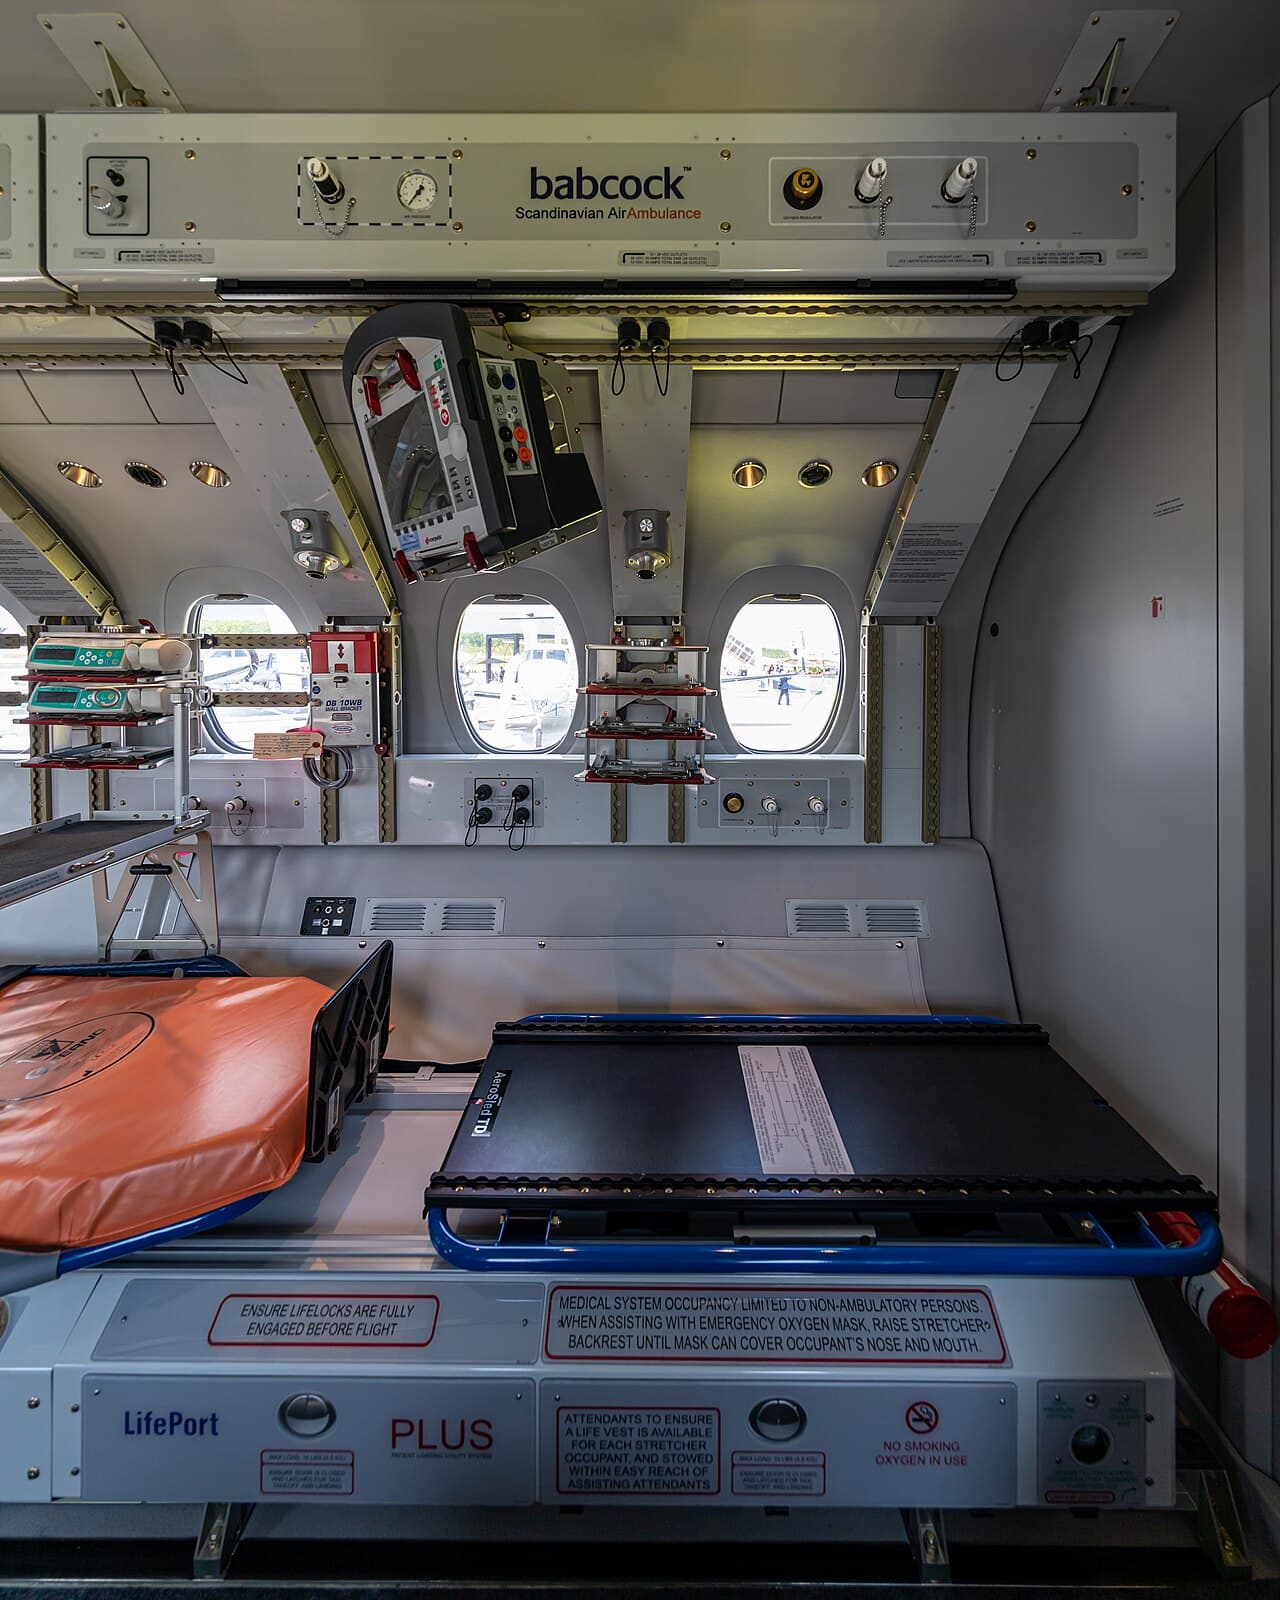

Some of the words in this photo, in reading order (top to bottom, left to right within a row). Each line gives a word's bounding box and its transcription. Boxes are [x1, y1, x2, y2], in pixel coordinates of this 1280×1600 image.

[530, 166, 685, 200] babcock
[516, 206, 604, 220] Scandinavian
[608, 206, 701, 220] AirAmbulance
[480, 1072, 506, 1116] AeroSled
[474, 1118, 490, 1134] TD
[240, 1304, 290, 1317] ENSURE
[290, 1304, 353, 1318] LIFELOCKS
[352, 1304, 378, 1318] ARE
[378, 1305, 414, 1318] FULLY
[560, 1296, 611, 1310] MEDICAL
[614, 1296, 662, 1310] SYSTEM
[664, 1297, 737, 1311] OCCUPANCY
[742, 1298, 787, 1312] LIMITED
[792, 1298, 806, 1312] TO
[810, 1298, 917, 1312] NON-AMBULATORY
[922, 1300, 982, 1312] PERSONS.
[246, 1322, 305, 1336] ENGAGED
[306, 1322, 354, 1336] BEFORE
[356, 1323, 398, 1336] FLIGHT
[561, 1315, 596, 1328] WHEN
[600, 1316, 662, 1329] ASSISTING
[666, 1316, 696, 1329] WITH
[700, 1316, 774, 1330] EMERGENCY
[778, 1317, 828, 1331] OXYGEN
[832, 1318, 870, 1332] MASK,
[874, 1318, 908, 1332] RAISE
[912, 1318, 984, 1332] STRETCHER
[568, 1334, 633, 1349] BACKREST
[636, 1335, 670, 1349] UNTIL
[674, 1336, 708, 1350] MASK
[712, 1336, 736, 1350] CAN
[741, 1336, 783, 1350] COVER
[787, 1336, 864, 1351] OCCUPANT'S
[867, 1338, 902, 1351] NOSE
[905, 1338, 930, 1352] AND
[934, 1338, 982, 1352] MOUTH.
[124, 1411, 219, 1436] LifePort
[564, 1414, 642, 1424] ATTENDANTS
[645, 1414, 661, 1424] TO
[664, 1414, 712, 1424] ENSURE
[392, 1418, 494, 1450] PLUS
[565, 1427, 574, 1437] A
[576, 1427, 600, 1437] LIFE
[604, 1427, 634, 1437] VEST
[638, 1427, 648, 1437] IS
[650, 1427, 712, 1437] AVAILABLE
[572, 1440, 596, 1450] FOR
[600, 1440, 632, 1450] EACH
[636, 1440, 706, 1450] STRETCHER
[883, 1441, 900, 1451] NO
[904, 1441, 960, 1451] SMOKING
[634, 1454, 659, 1464] AND
[662, 1454, 714, 1464] STOWED
[876, 1456, 926, 1466] OXYGEN
[928, 1456, 940, 1466] IN
[944, 1456, 967, 1466] USE
[569, 1466, 610, 1476] WITHIN
[614, 1466, 644, 1476] EASY
[649, 1466, 689, 1476] REACH
[693, 1466, 708, 1476] OF
[568, 1479, 630, 1490] ASSISTING
[632, 1479, 710, 1490] ATTENDANTS
